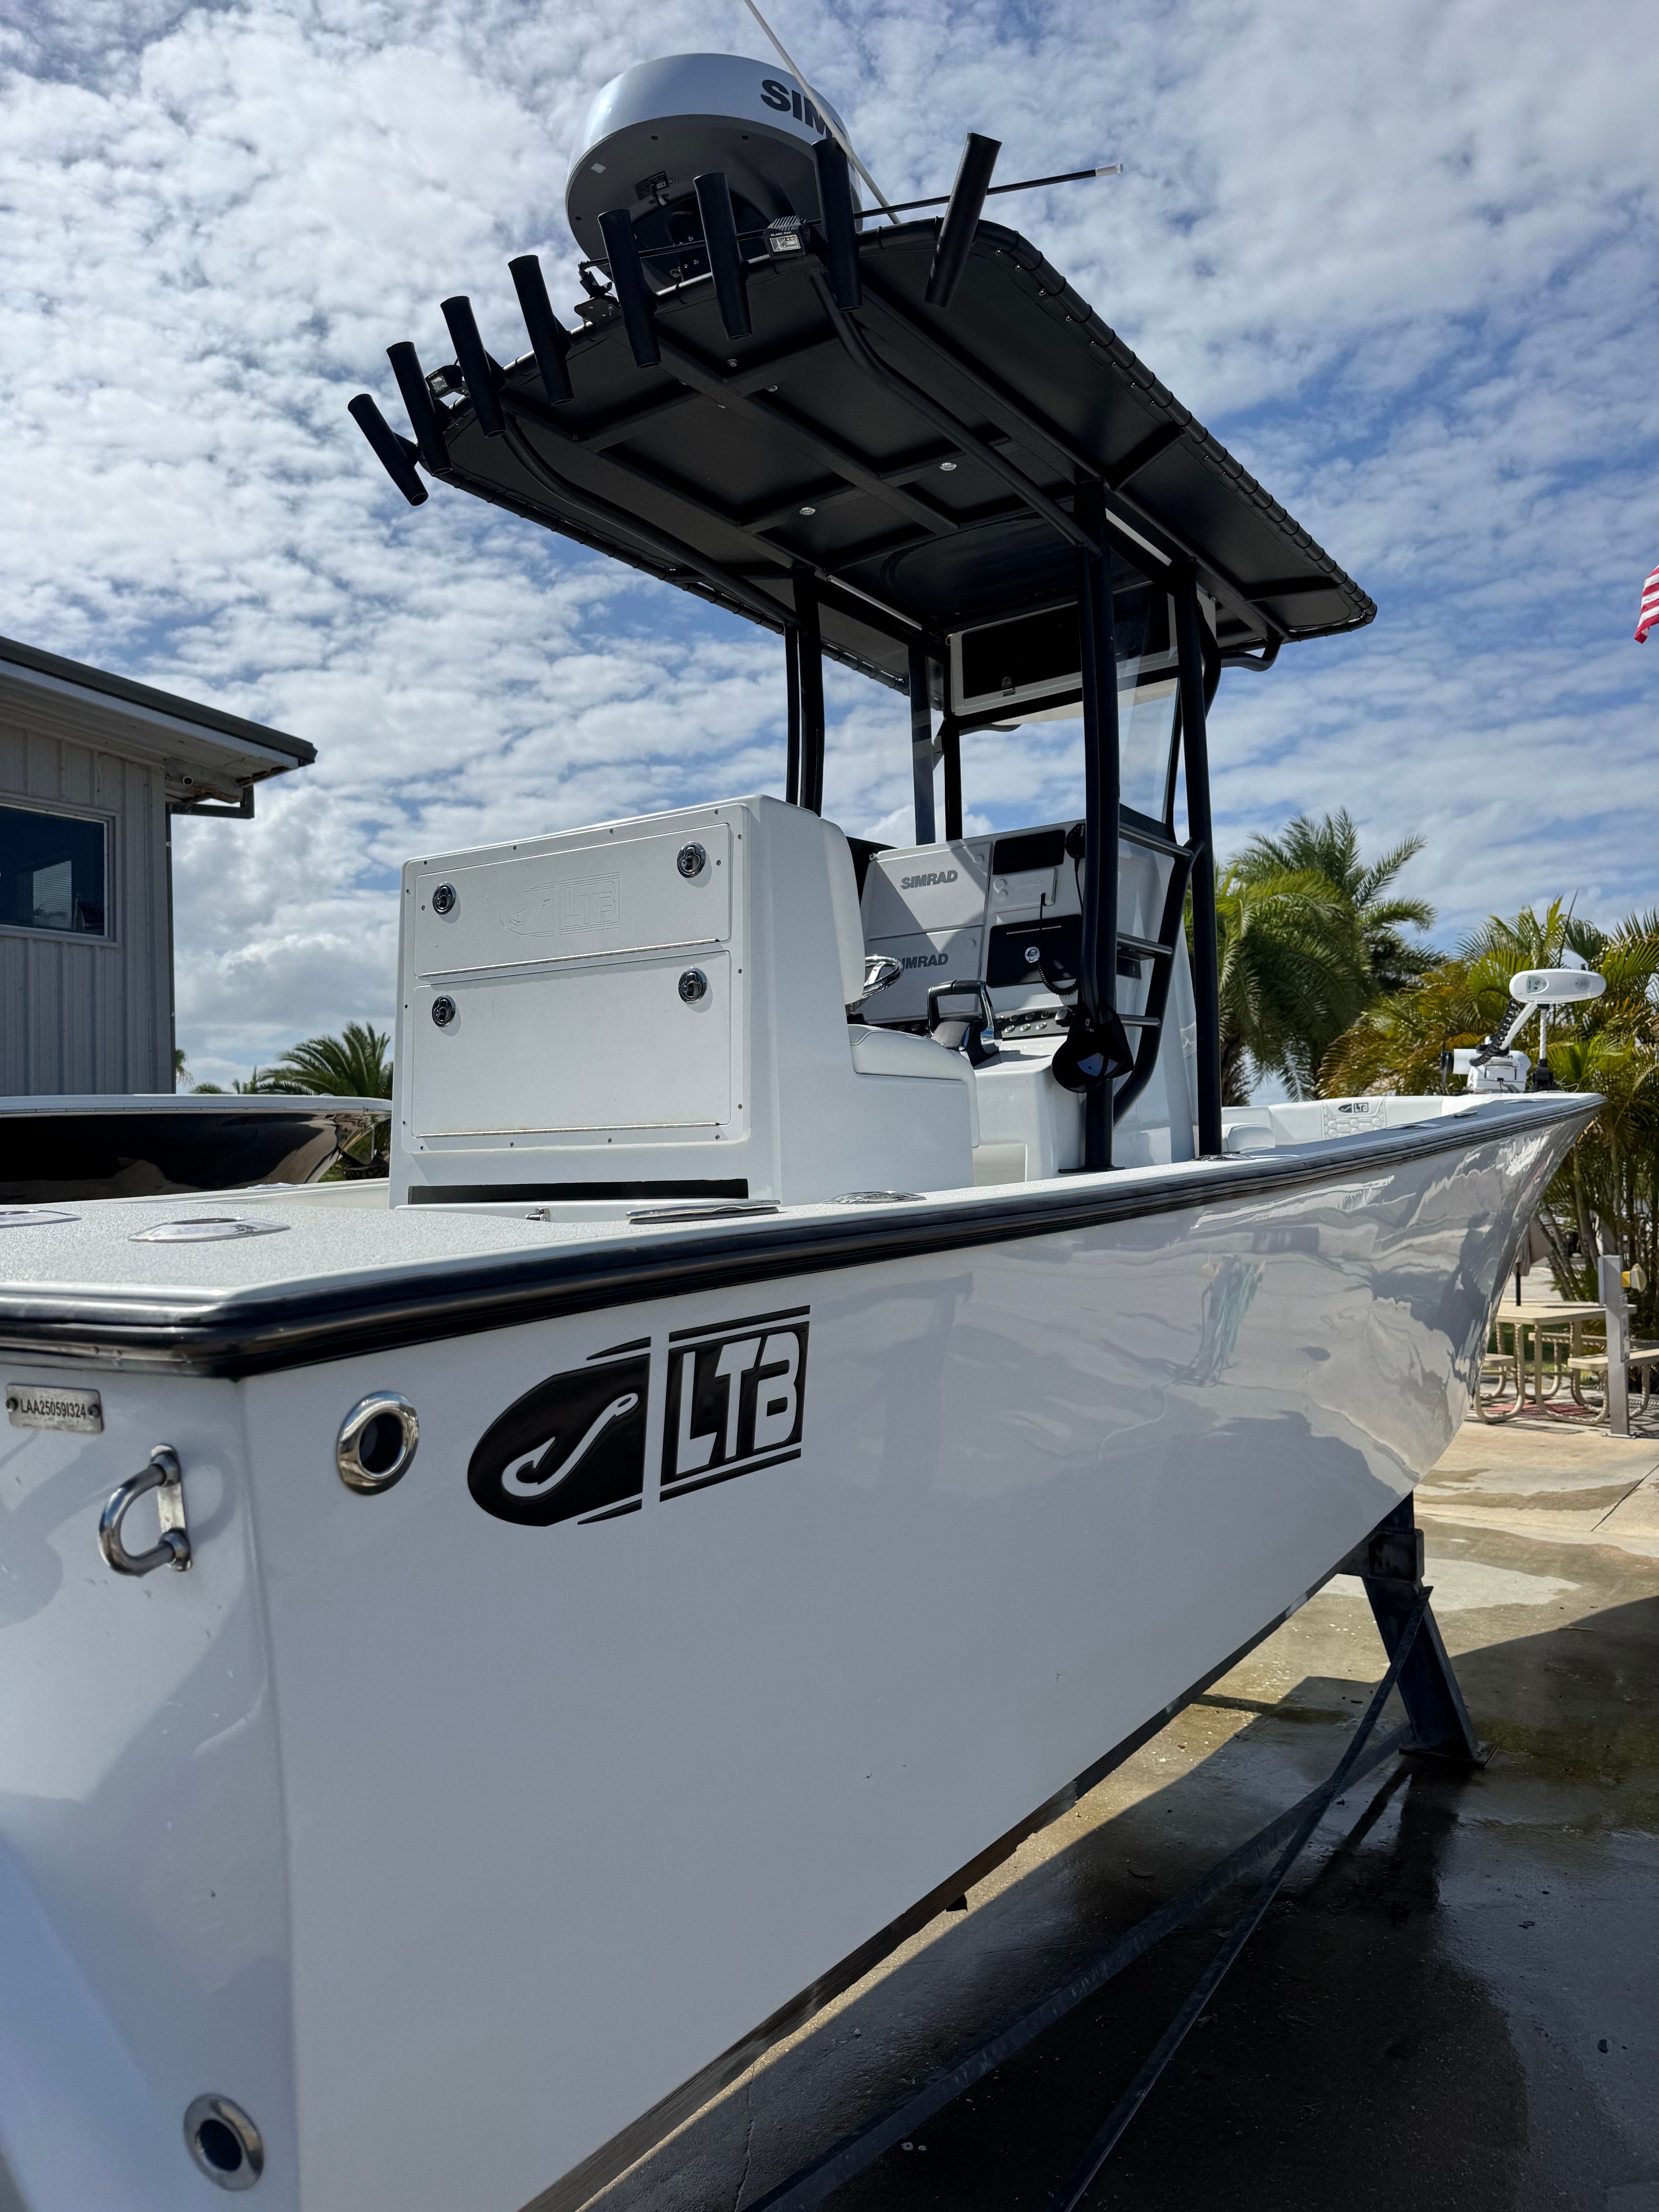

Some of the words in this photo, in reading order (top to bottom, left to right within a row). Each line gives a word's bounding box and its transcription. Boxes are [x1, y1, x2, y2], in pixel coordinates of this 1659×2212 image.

[761, 79, 846, 140] SIM
[901, 870, 958, 890] SIMRAD
[566, 881, 616, 927] LTB
[1355, 1103, 1369, 1112] LTB
[677, 1332, 799, 1475] LTB
